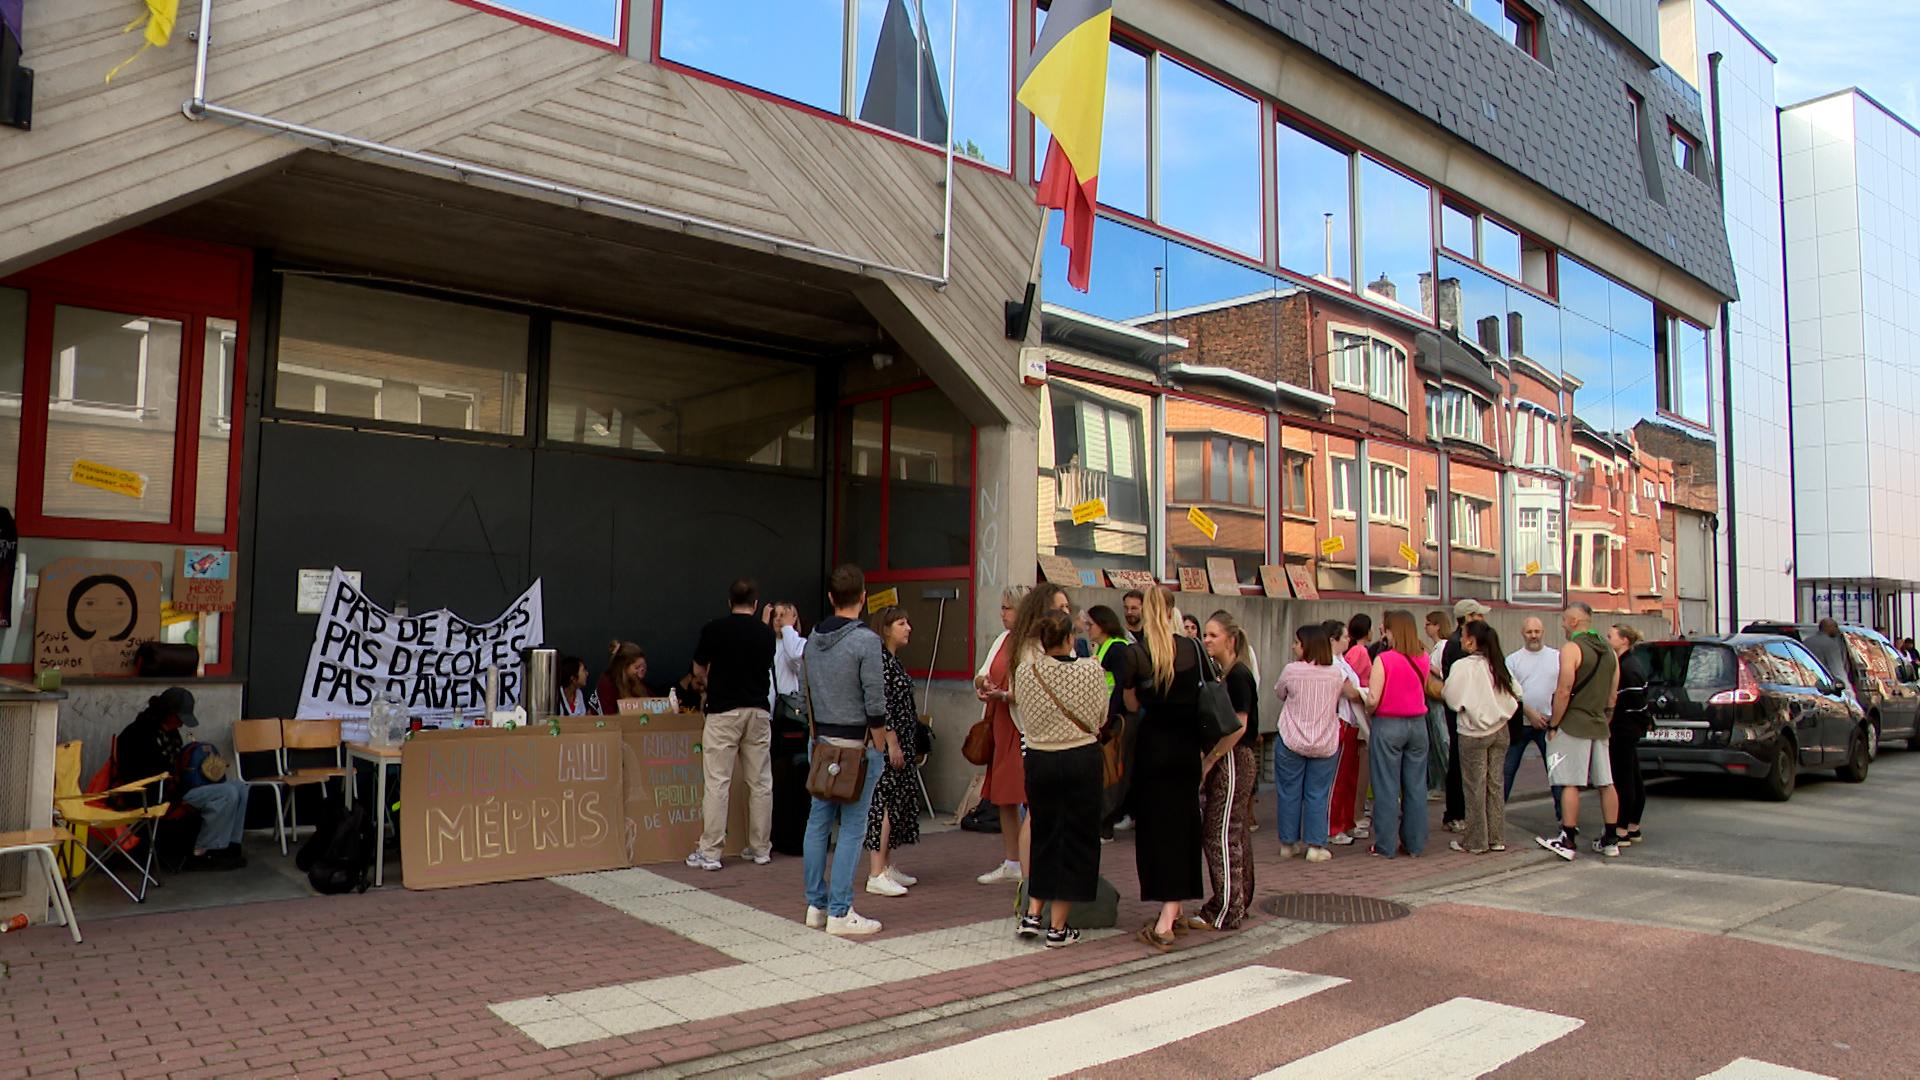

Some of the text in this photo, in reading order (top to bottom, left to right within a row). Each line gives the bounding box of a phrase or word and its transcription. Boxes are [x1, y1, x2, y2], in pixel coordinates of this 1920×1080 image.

[980, 481, 999, 587] NON
[331, 582, 389, 634] PAS
[397, 615, 438, 646] DE
[446, 598, 531, 647] PROFS
[320, 620, 382, 670] PAS
[312, 661, 376, 706] PAS
[428, 740, 609, 800] NON AU
[643, 735, 689, 759] NON
[426, 790, 610, 865] MÉPRIS
[644, 813, 662, 831] DE
